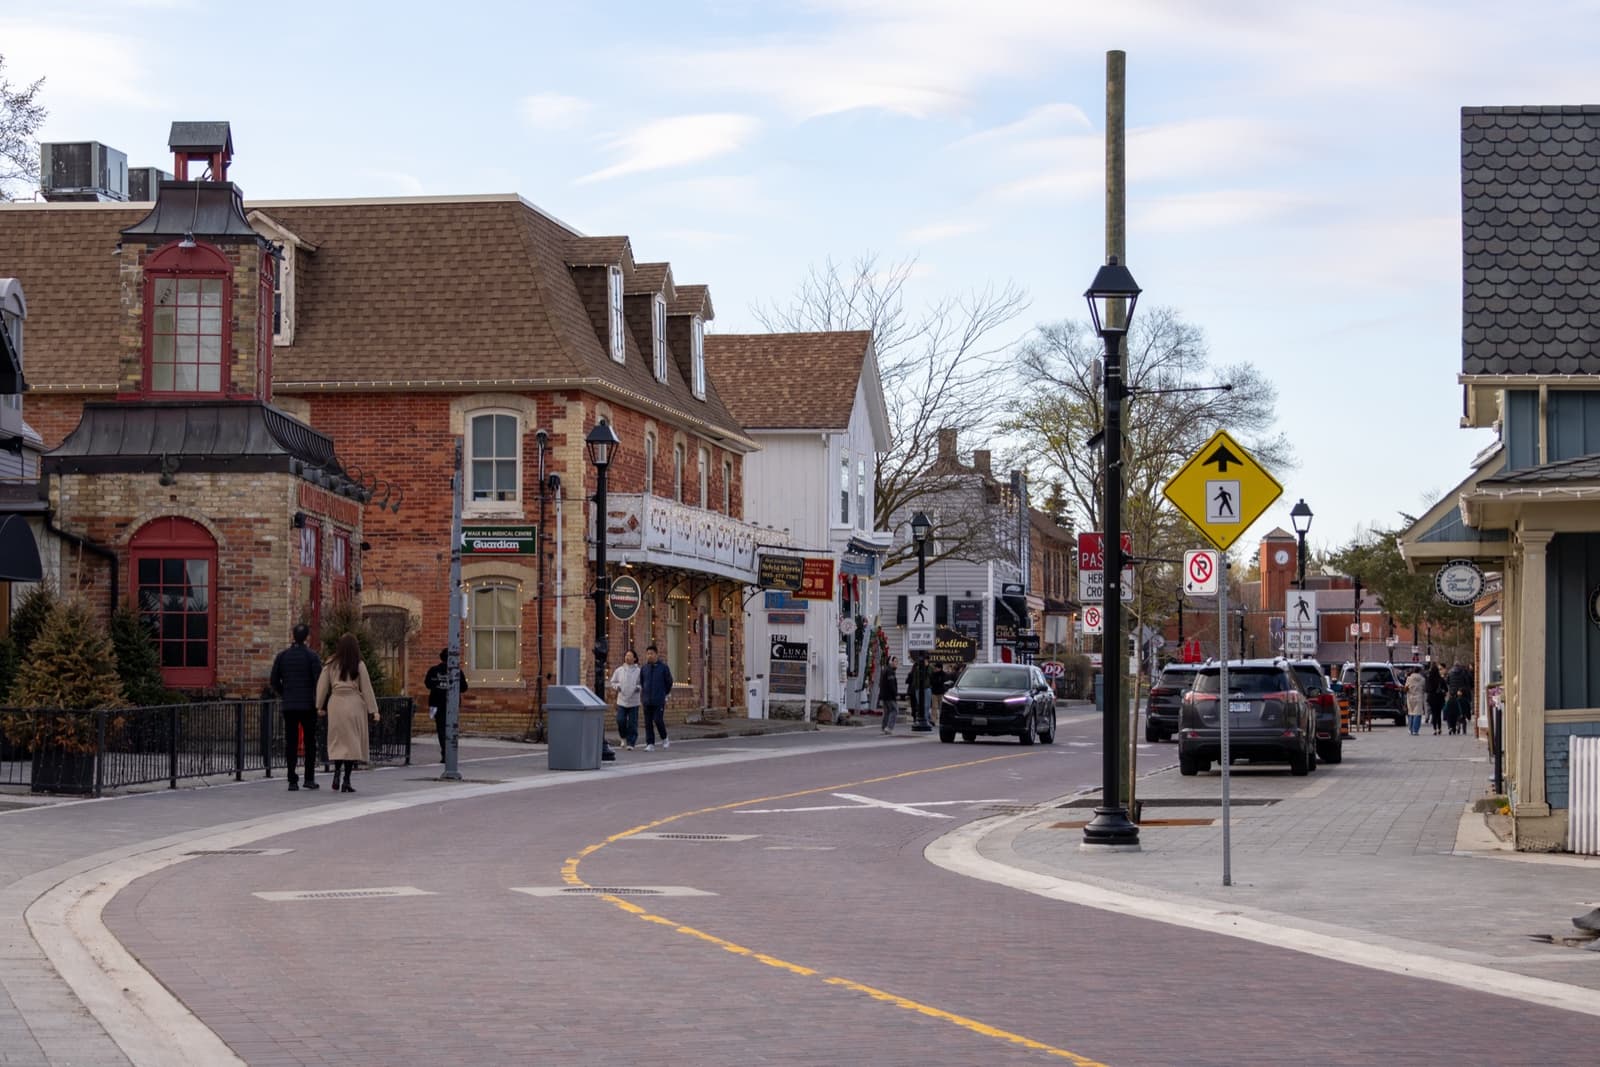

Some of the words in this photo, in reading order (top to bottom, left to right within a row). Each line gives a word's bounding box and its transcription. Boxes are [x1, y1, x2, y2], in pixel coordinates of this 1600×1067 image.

[473, 540, 519, 549] Guardian
[1088, 574, 1104, 584] HER
[783, 648, 807, 656] LUNA
